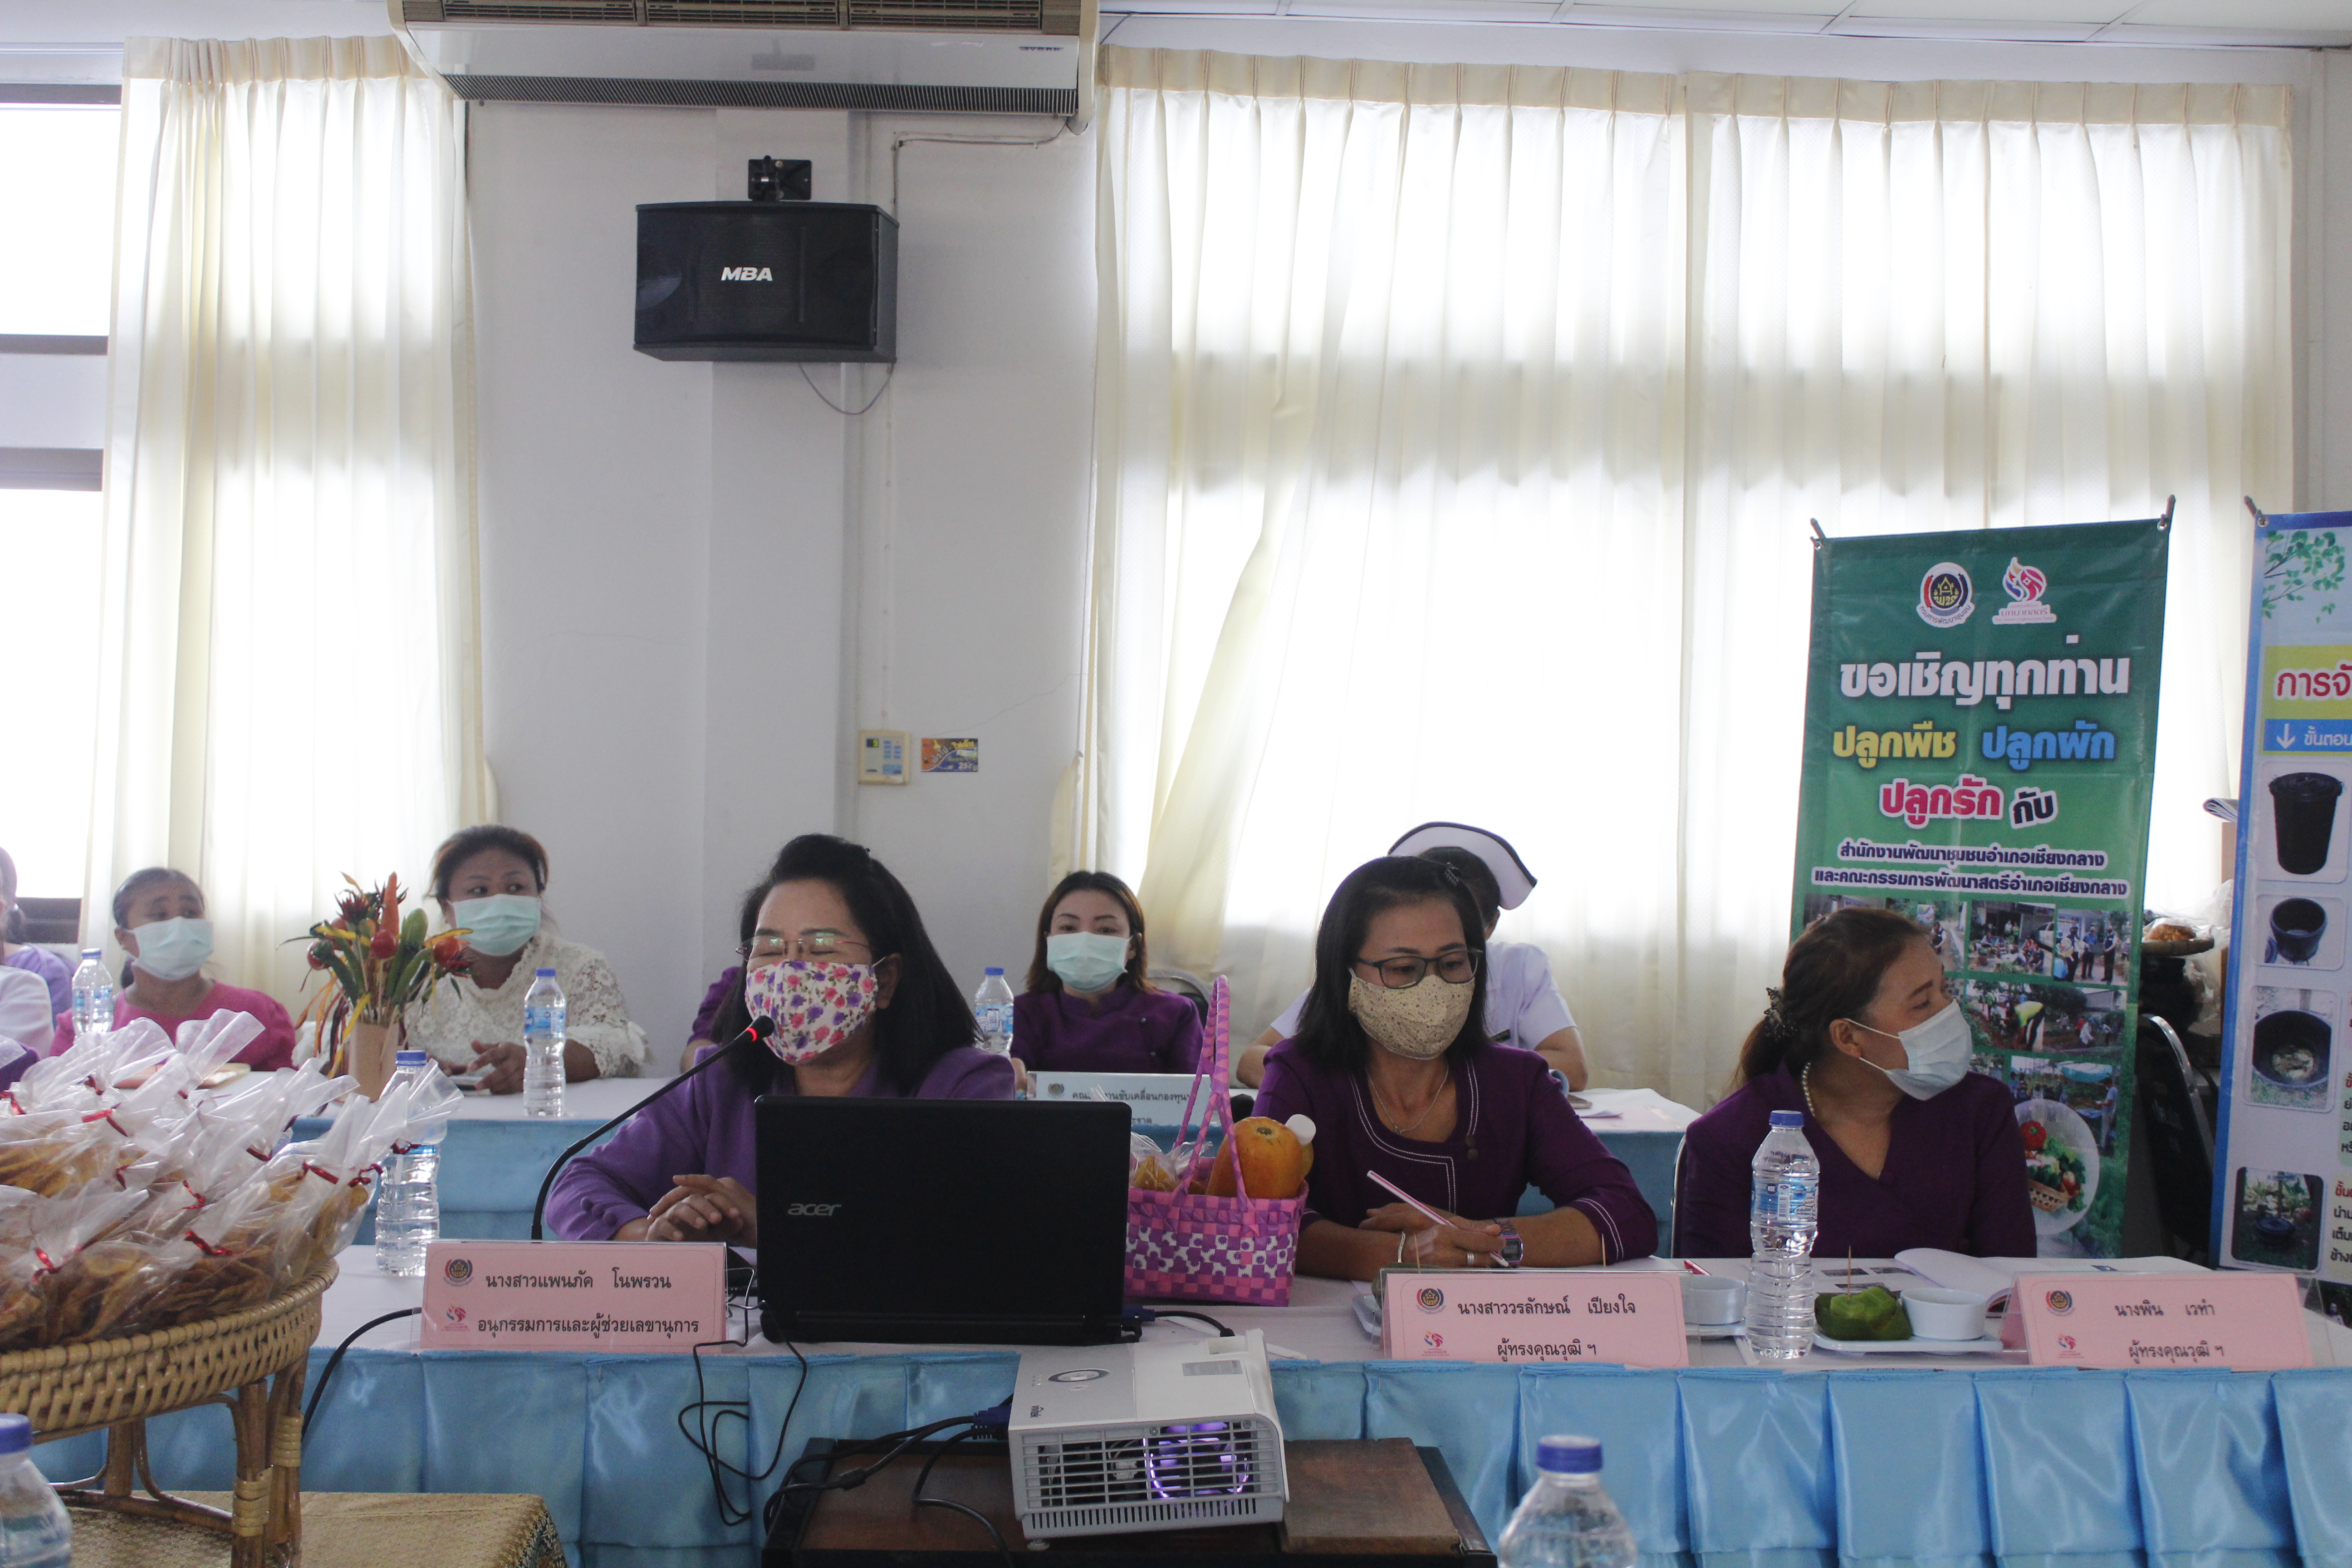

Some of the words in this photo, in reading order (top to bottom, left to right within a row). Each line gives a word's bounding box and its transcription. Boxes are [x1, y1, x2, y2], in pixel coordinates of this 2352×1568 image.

[720, 267, 773, 281] MBA
[1840, 635, 2130, 710] ขอเชิญทุกท่าน
[1833, 720, 1956, 769] ปลูกพืช
[1982, 720, 2115, 770] ปลูกผัก
[1882, 777, 2000, 825] ปลูกรัก
[2013, 791, 2055, 824] กับ
[1840, 840, 2105, 867] สำนักงานพัฒนาชุมชนอำเภอเชียงกลาง
[1815, 869, 2127, 896] และคณะกรรมการพัฒนาสตรีอำเภอเชียงกลาง
[787, 1203, 842, 1216] acer
[485, 1269, 593, 1288] นางสาวแพนภัค
[612, 1266, 672, 1288] โนพรวน
[1458, 1295, 1571, 1314] นางสาววรลักษณ์
[1588, 1293, 1636, 1314] เปียงใจ
[478, 1313, 699, 1339] อนุกรรมการและผู้ช่วยเลขานุการ
[1497, 1337, 1582, 1362] ผู้ทรงคุณวุฒิ
[2129, 1339, 2210, 1364] ผู้ทรงคุณวุฒิ
